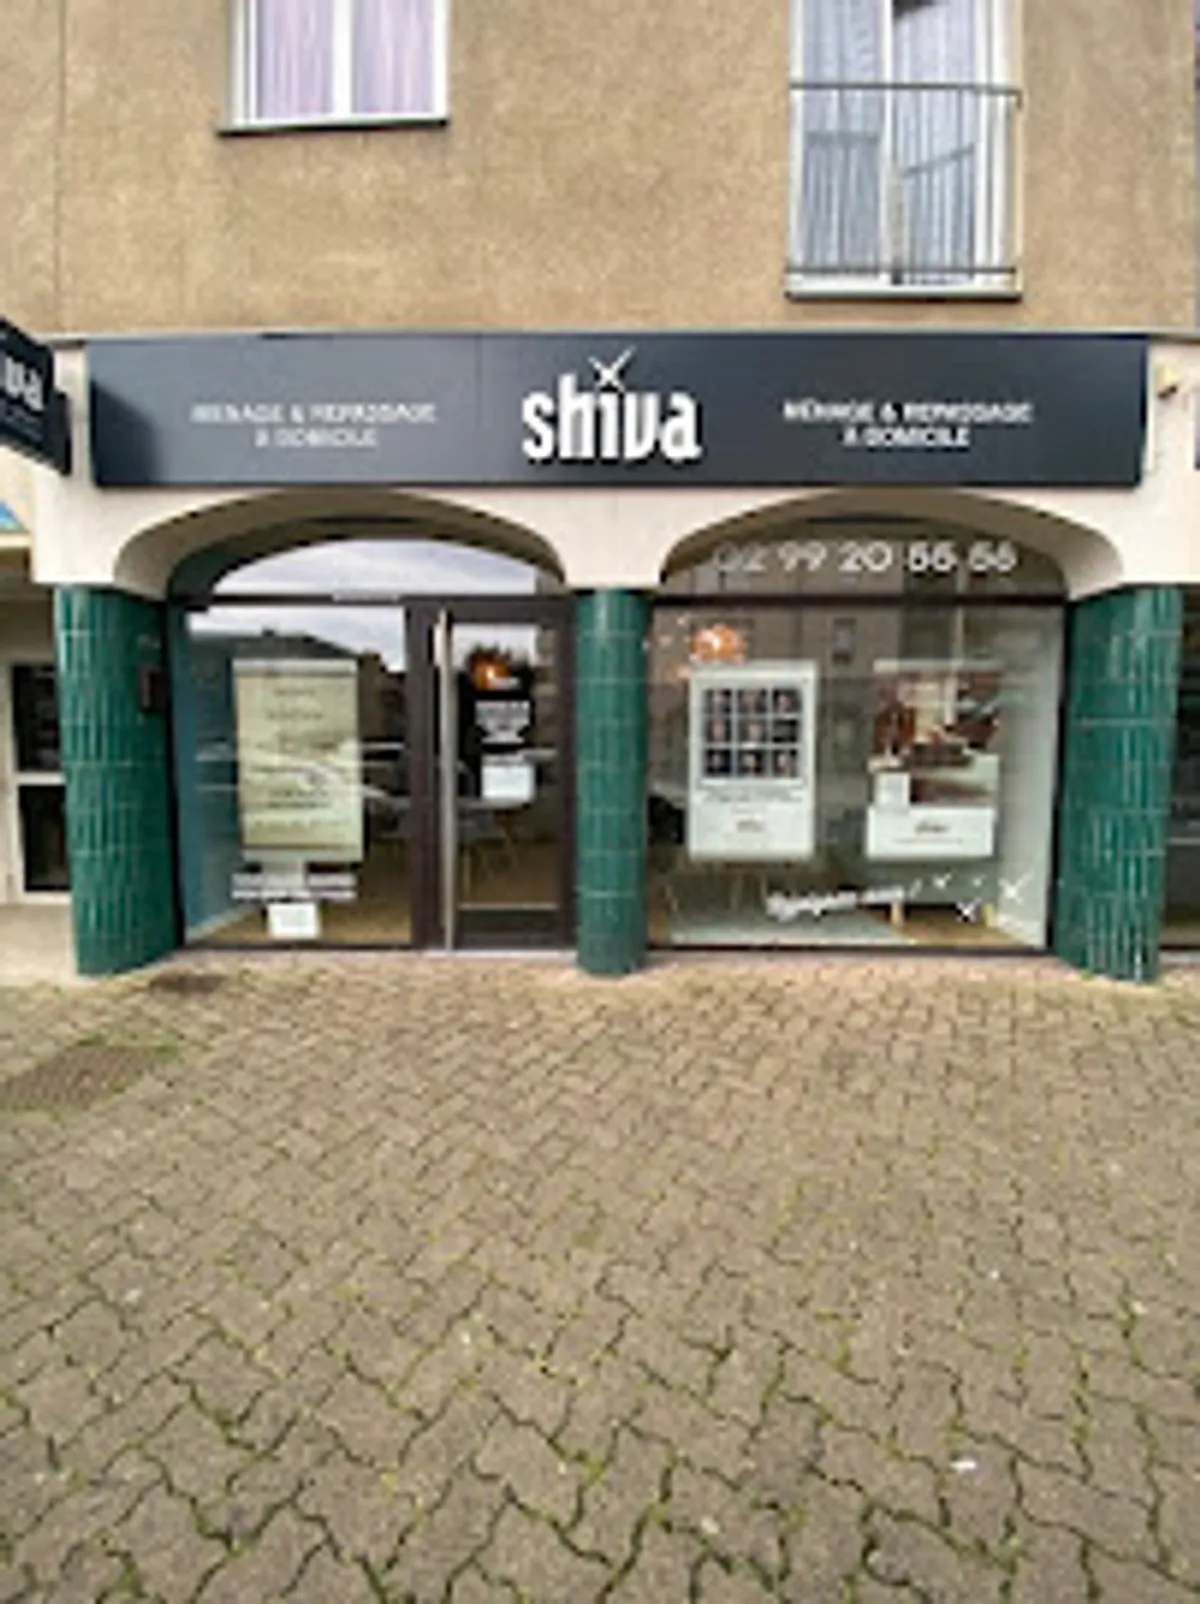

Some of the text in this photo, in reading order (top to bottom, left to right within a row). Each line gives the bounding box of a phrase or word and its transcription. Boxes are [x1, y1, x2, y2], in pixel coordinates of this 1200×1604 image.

[522, 360, 703, 460] shiva
[777, 541, 827, 572] 99
[838, 541, 892, 572] 20
